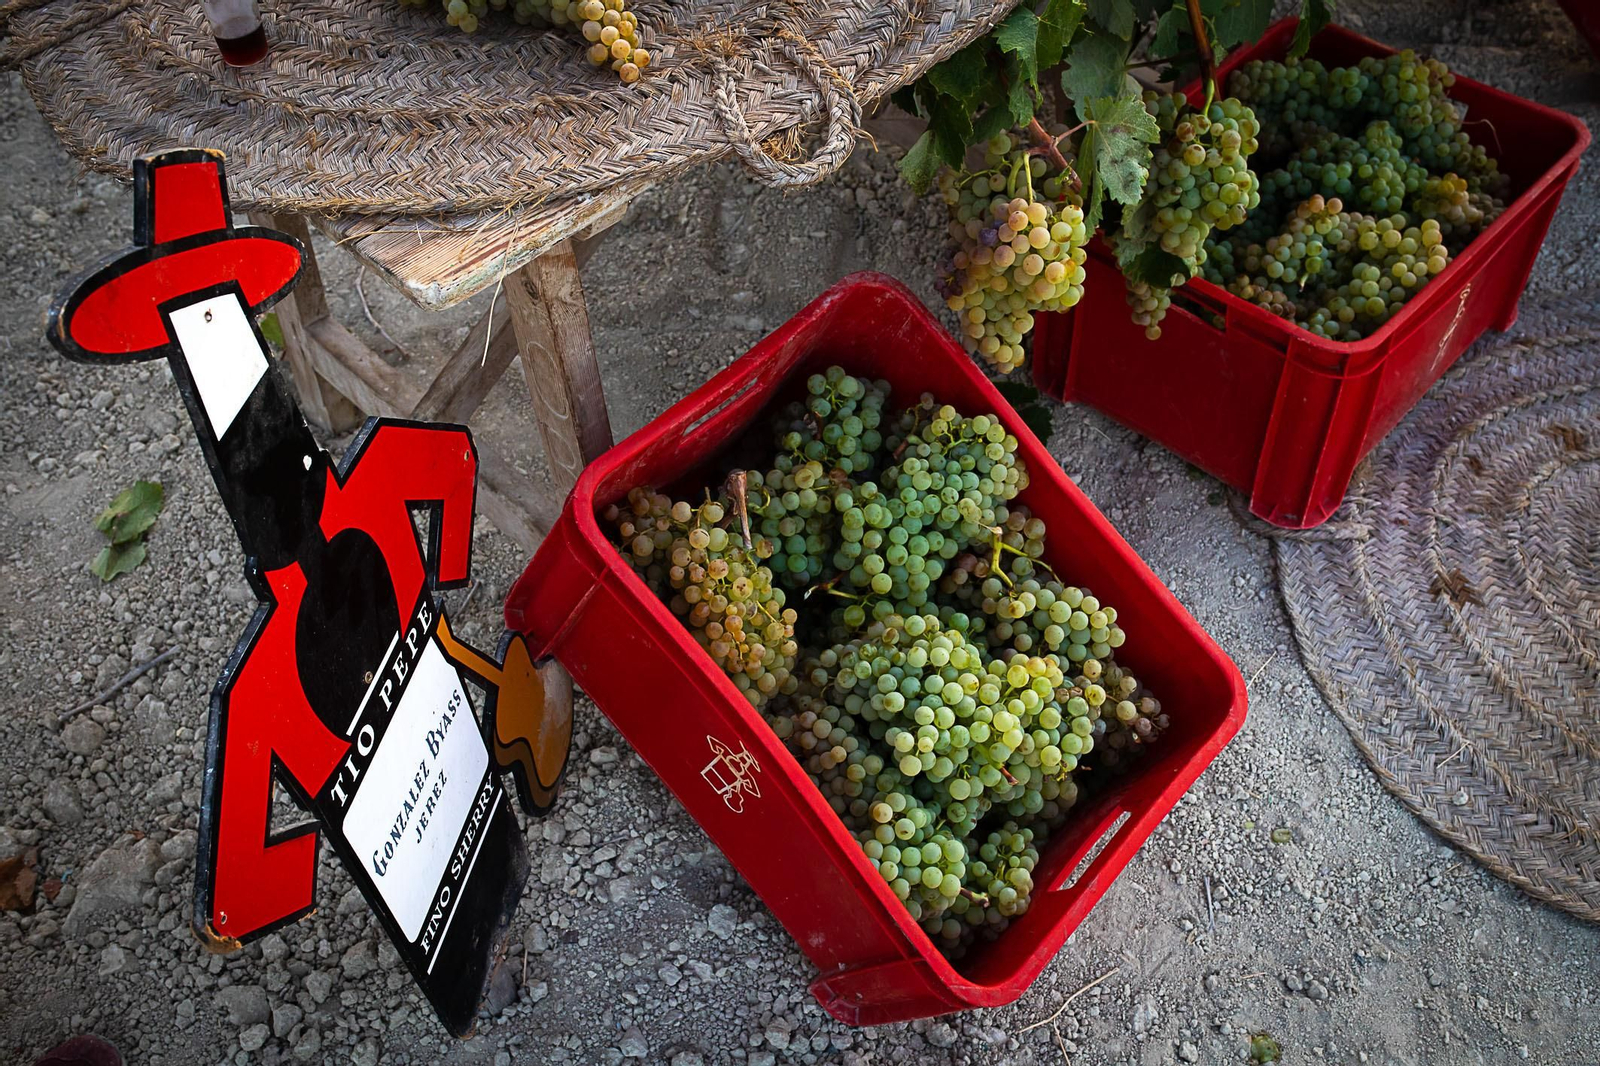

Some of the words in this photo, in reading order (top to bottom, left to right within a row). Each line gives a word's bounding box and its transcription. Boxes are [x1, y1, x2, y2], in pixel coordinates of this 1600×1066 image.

[329, 723, 375, 807] TIO
[378, 601, 433, 712] PEPE
[373, 760, 430, 877] GONZALEZ
[425, 689, 462, 759] BYASS
[415, 769, 448, 844] JEREZ
[420, 886, 451, 955] FINO
[451, 772, 496, 880] SHERRY
